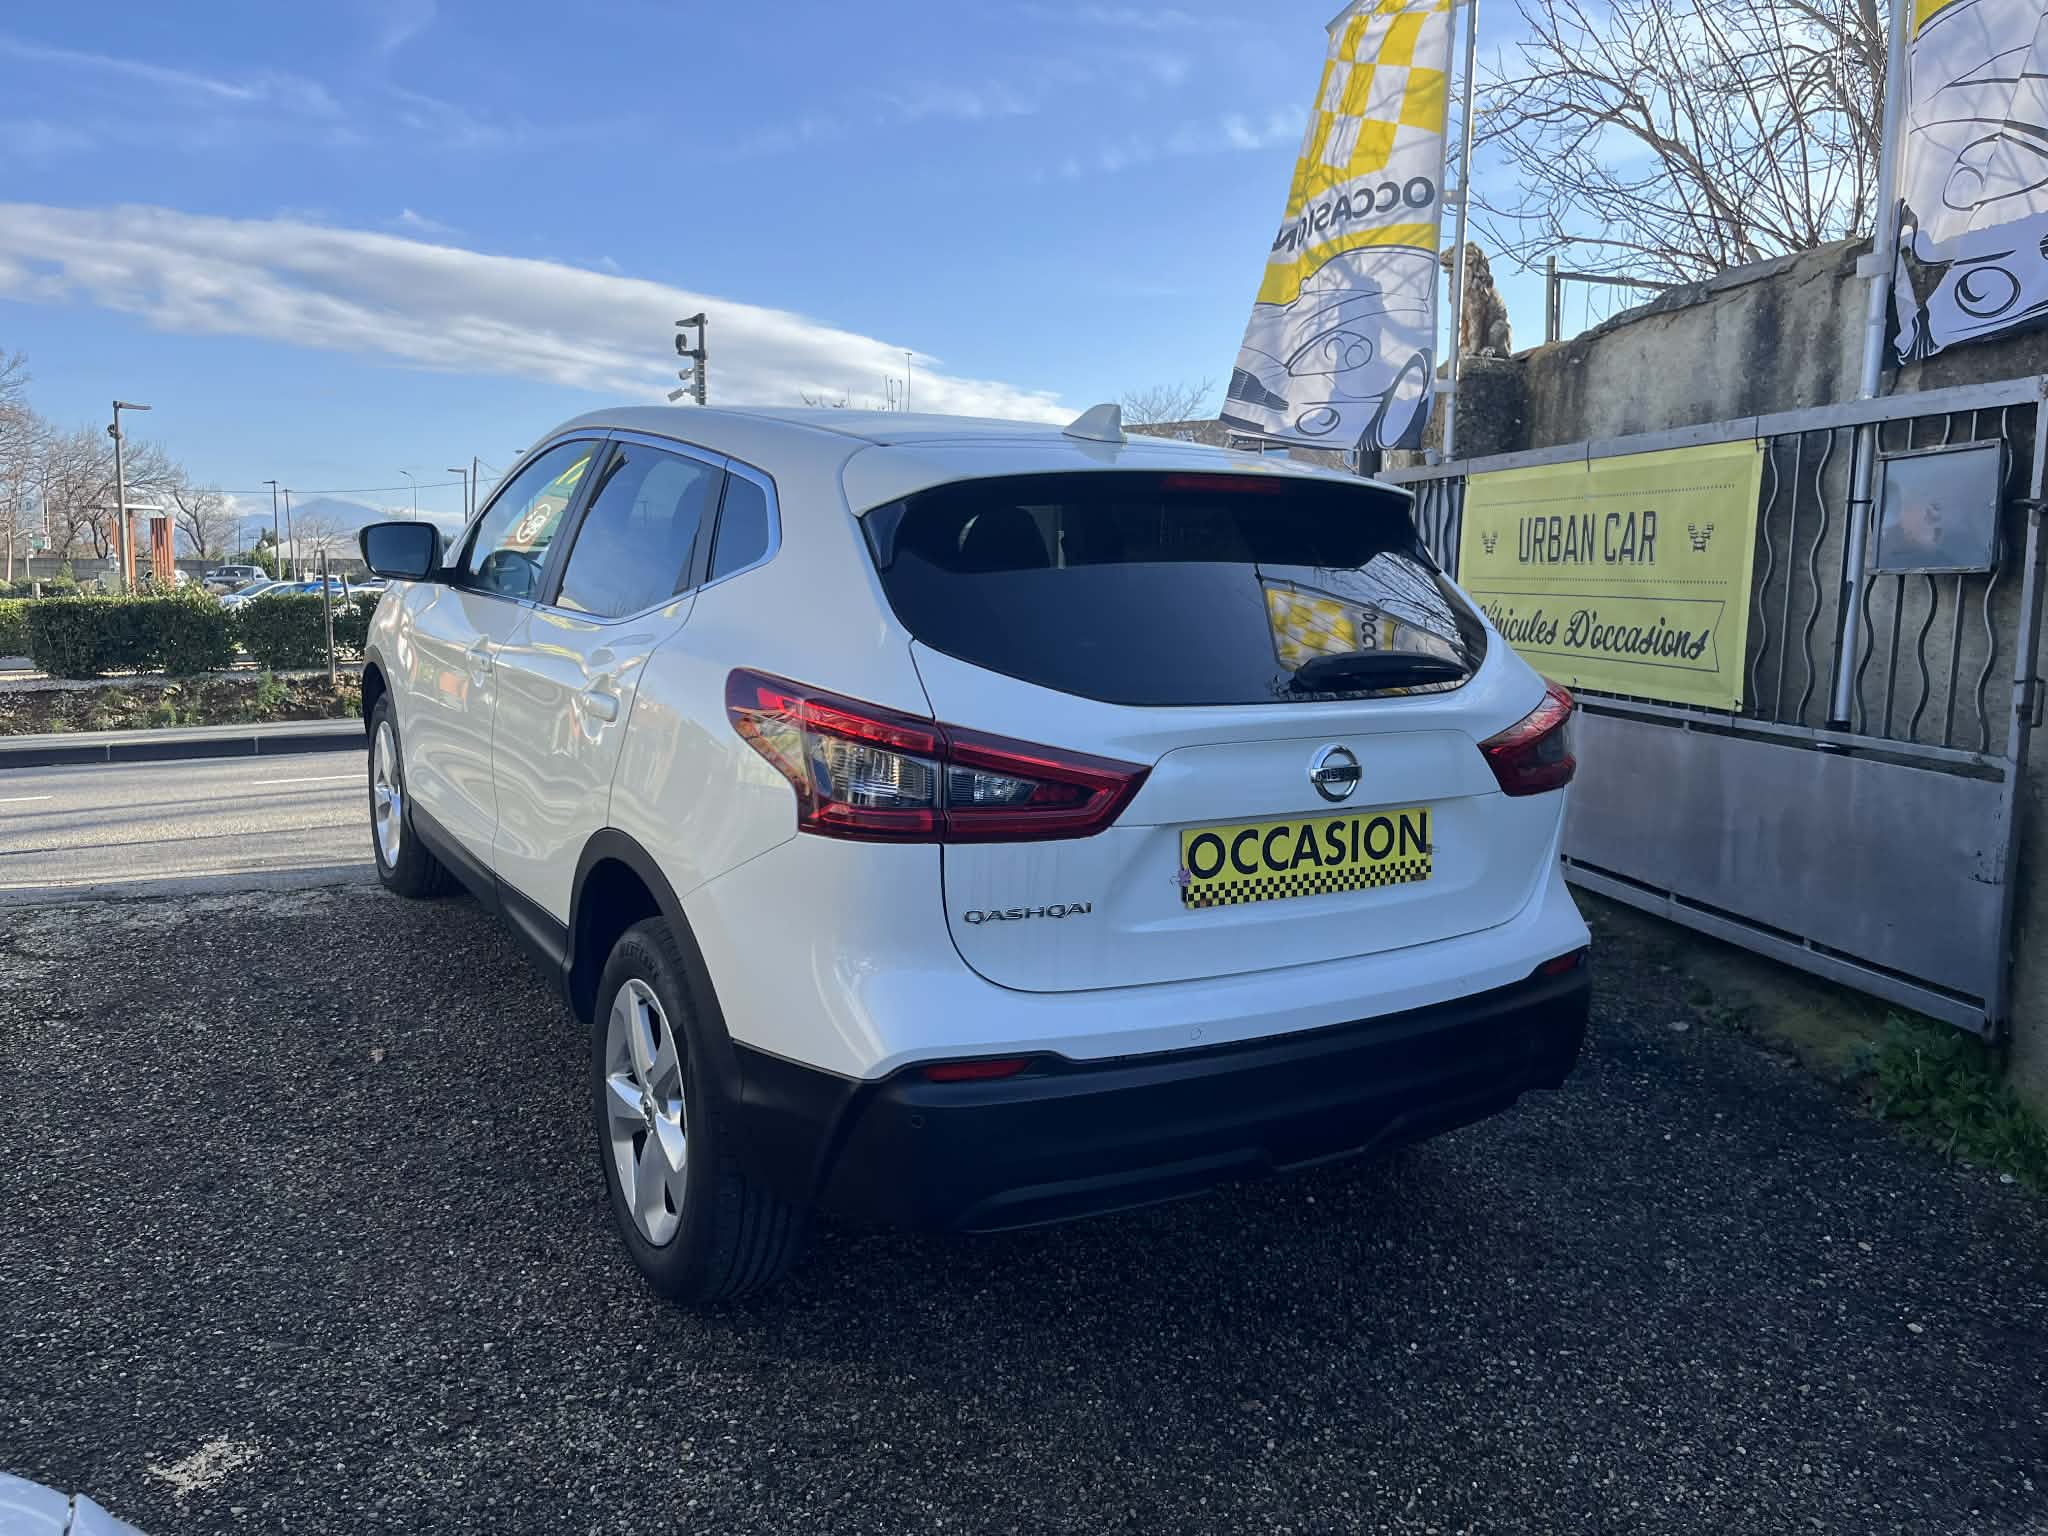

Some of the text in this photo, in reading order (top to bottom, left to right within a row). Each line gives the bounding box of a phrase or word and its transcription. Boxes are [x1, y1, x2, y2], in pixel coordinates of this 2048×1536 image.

[1518, 510, 1657, 566] URBAN CAR
[1187, 811, 1428, 880] OCCASION
[963, 902, 1093, 925] QASHQAI
